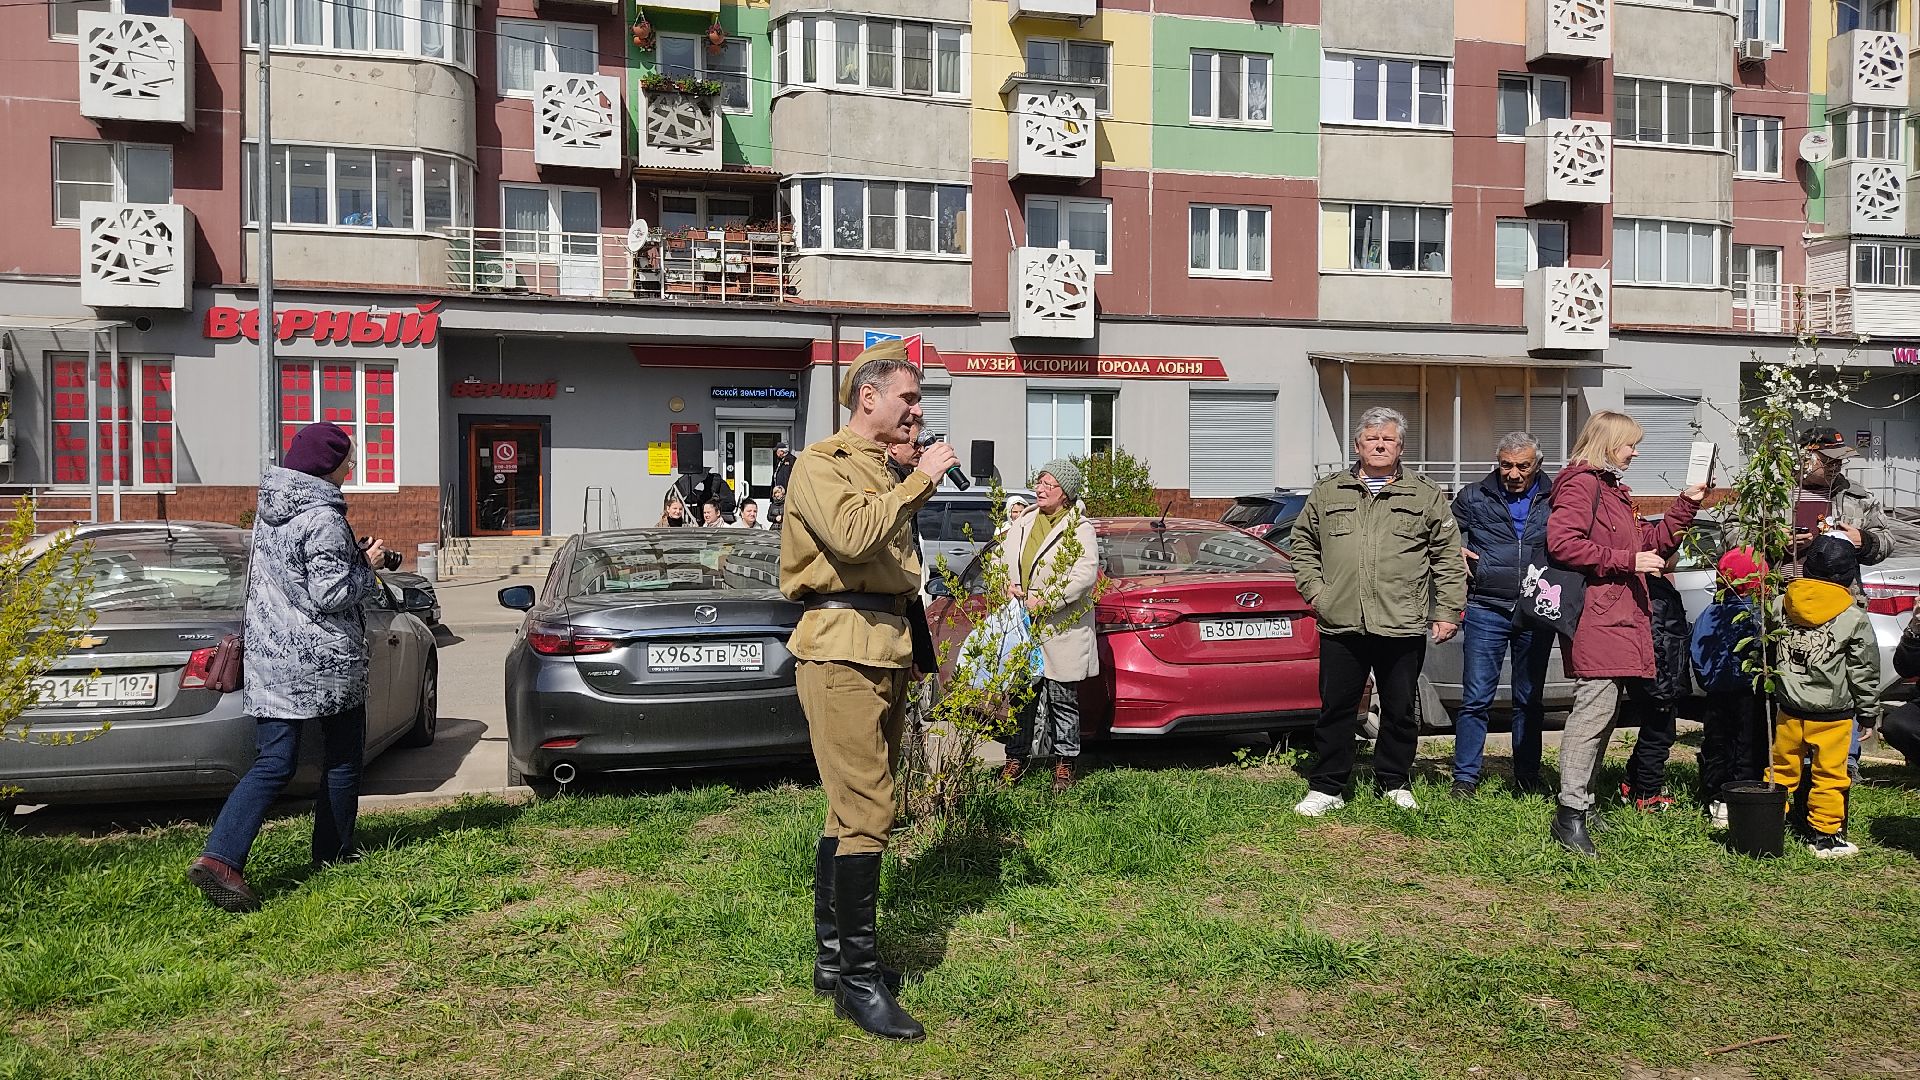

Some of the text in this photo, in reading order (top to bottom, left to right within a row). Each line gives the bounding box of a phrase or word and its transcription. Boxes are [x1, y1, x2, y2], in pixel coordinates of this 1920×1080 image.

[967, 356, 1203, 374] МУЗЕЙ ИСТОРИИ ГОРОДА ЛОБНЯ
[769, 388, 797, 398] Побед
[1265, 618, 1287, 631] 750
[655, 644, 758, 663] Х963ТВ 750
[118, 676, 150, 692] 197
